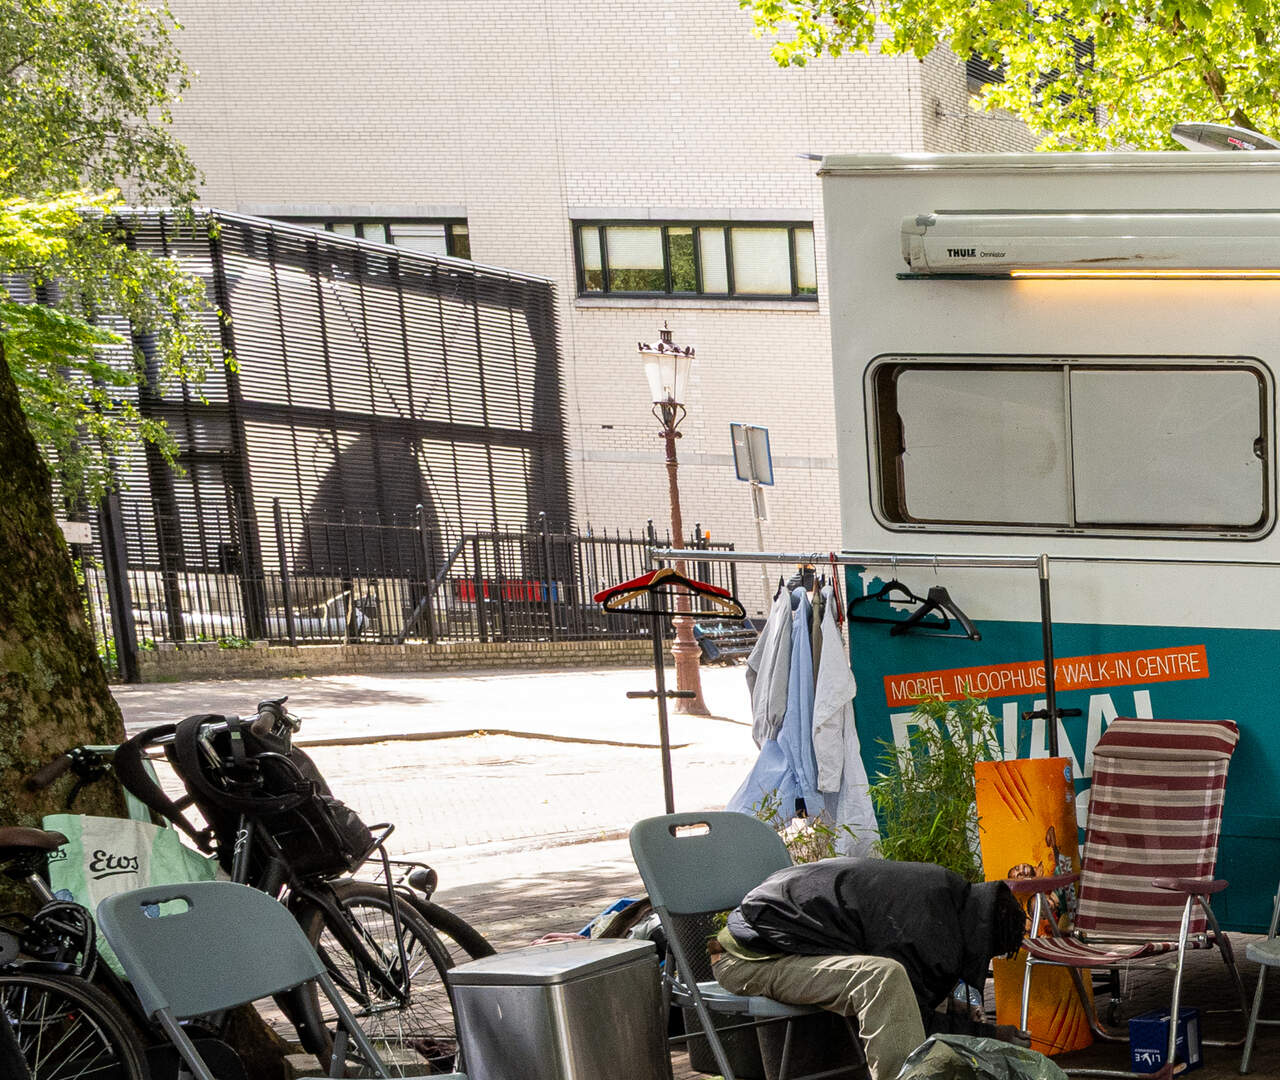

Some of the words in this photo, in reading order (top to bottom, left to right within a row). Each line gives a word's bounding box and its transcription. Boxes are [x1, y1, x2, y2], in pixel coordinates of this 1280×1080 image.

[946, 248, 977, 258] THULE
[891, 676, 951, 700] MOBIEL
[1062, 659, 1132, 684] WALK-IN
[1135, 652, 1201, 678] CENTRE
[89, 849, 139, 874] Etos
